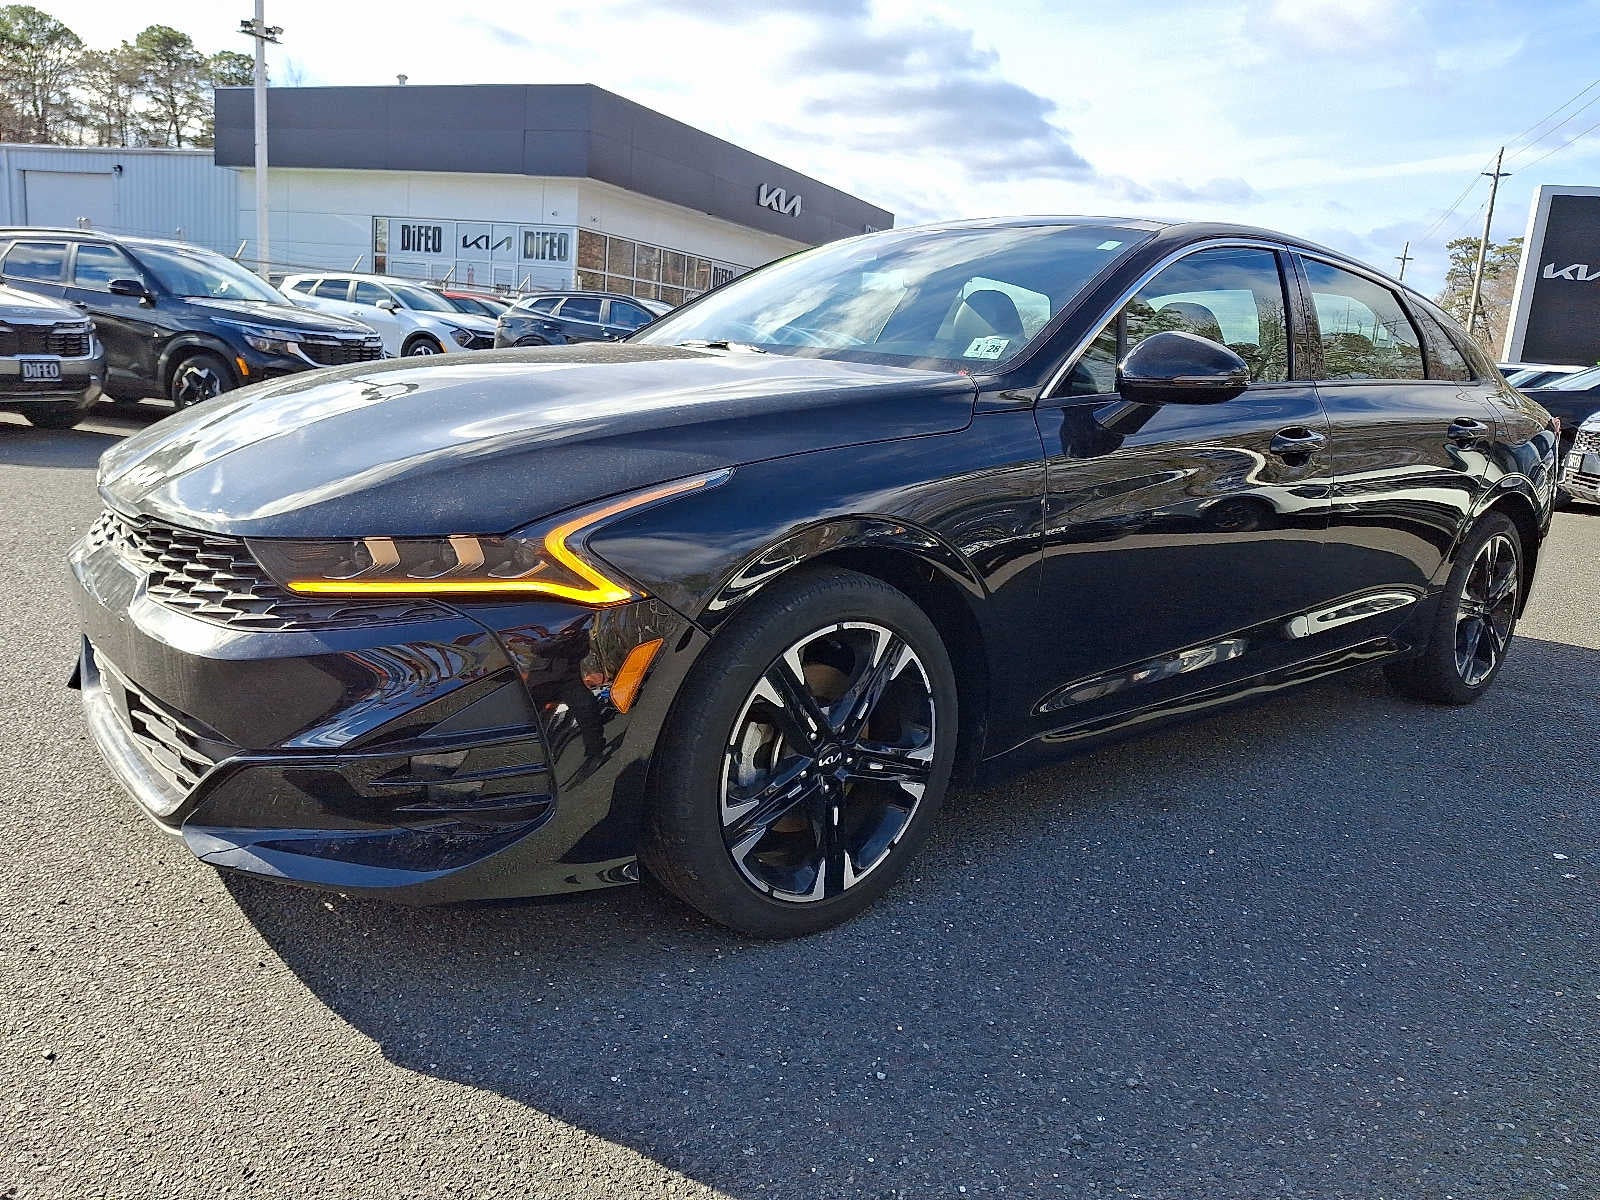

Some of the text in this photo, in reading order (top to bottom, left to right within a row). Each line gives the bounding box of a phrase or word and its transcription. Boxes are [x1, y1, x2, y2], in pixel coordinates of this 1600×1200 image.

[759, 184, 801, 217] KIA
[462, 234, 512, 251] KIA
[819, 752, 842, 767] KIA
